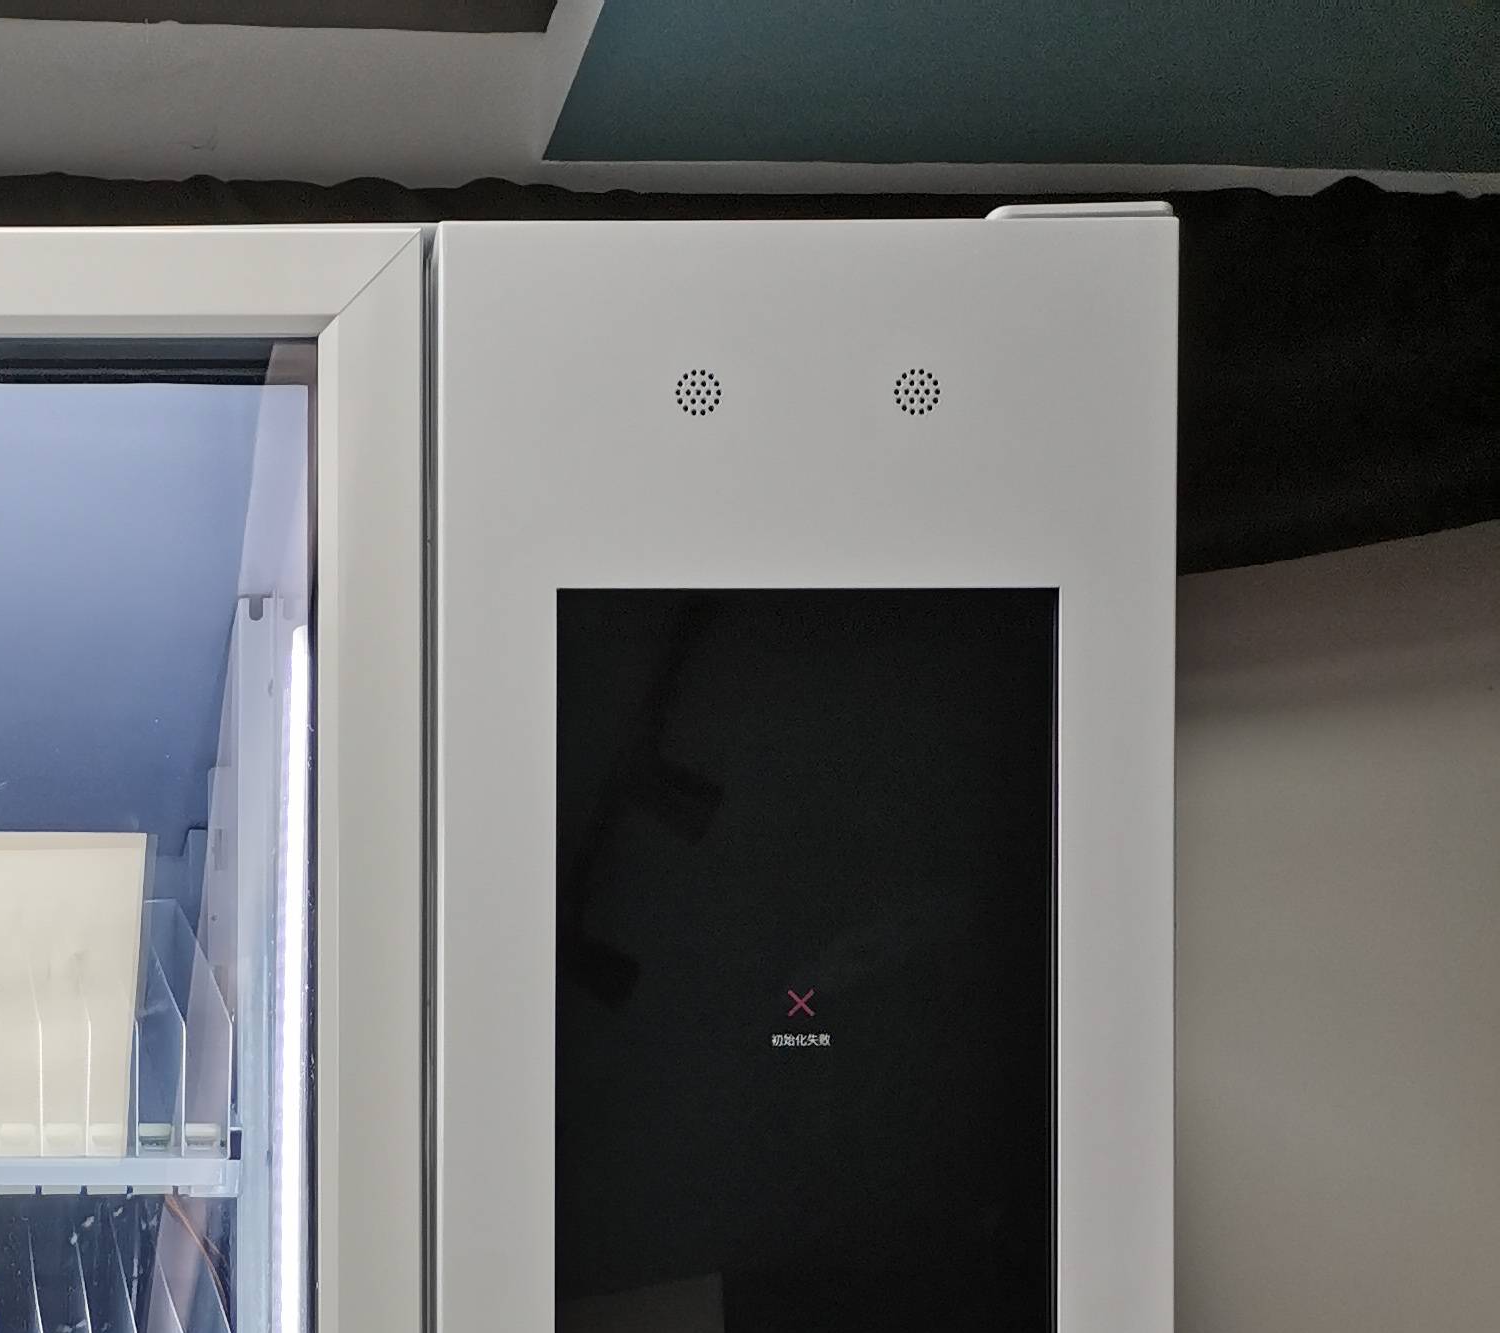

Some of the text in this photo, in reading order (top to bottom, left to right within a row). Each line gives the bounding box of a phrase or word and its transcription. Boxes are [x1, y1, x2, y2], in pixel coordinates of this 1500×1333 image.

[771, 1033, 831, 1047] 初始化失败
